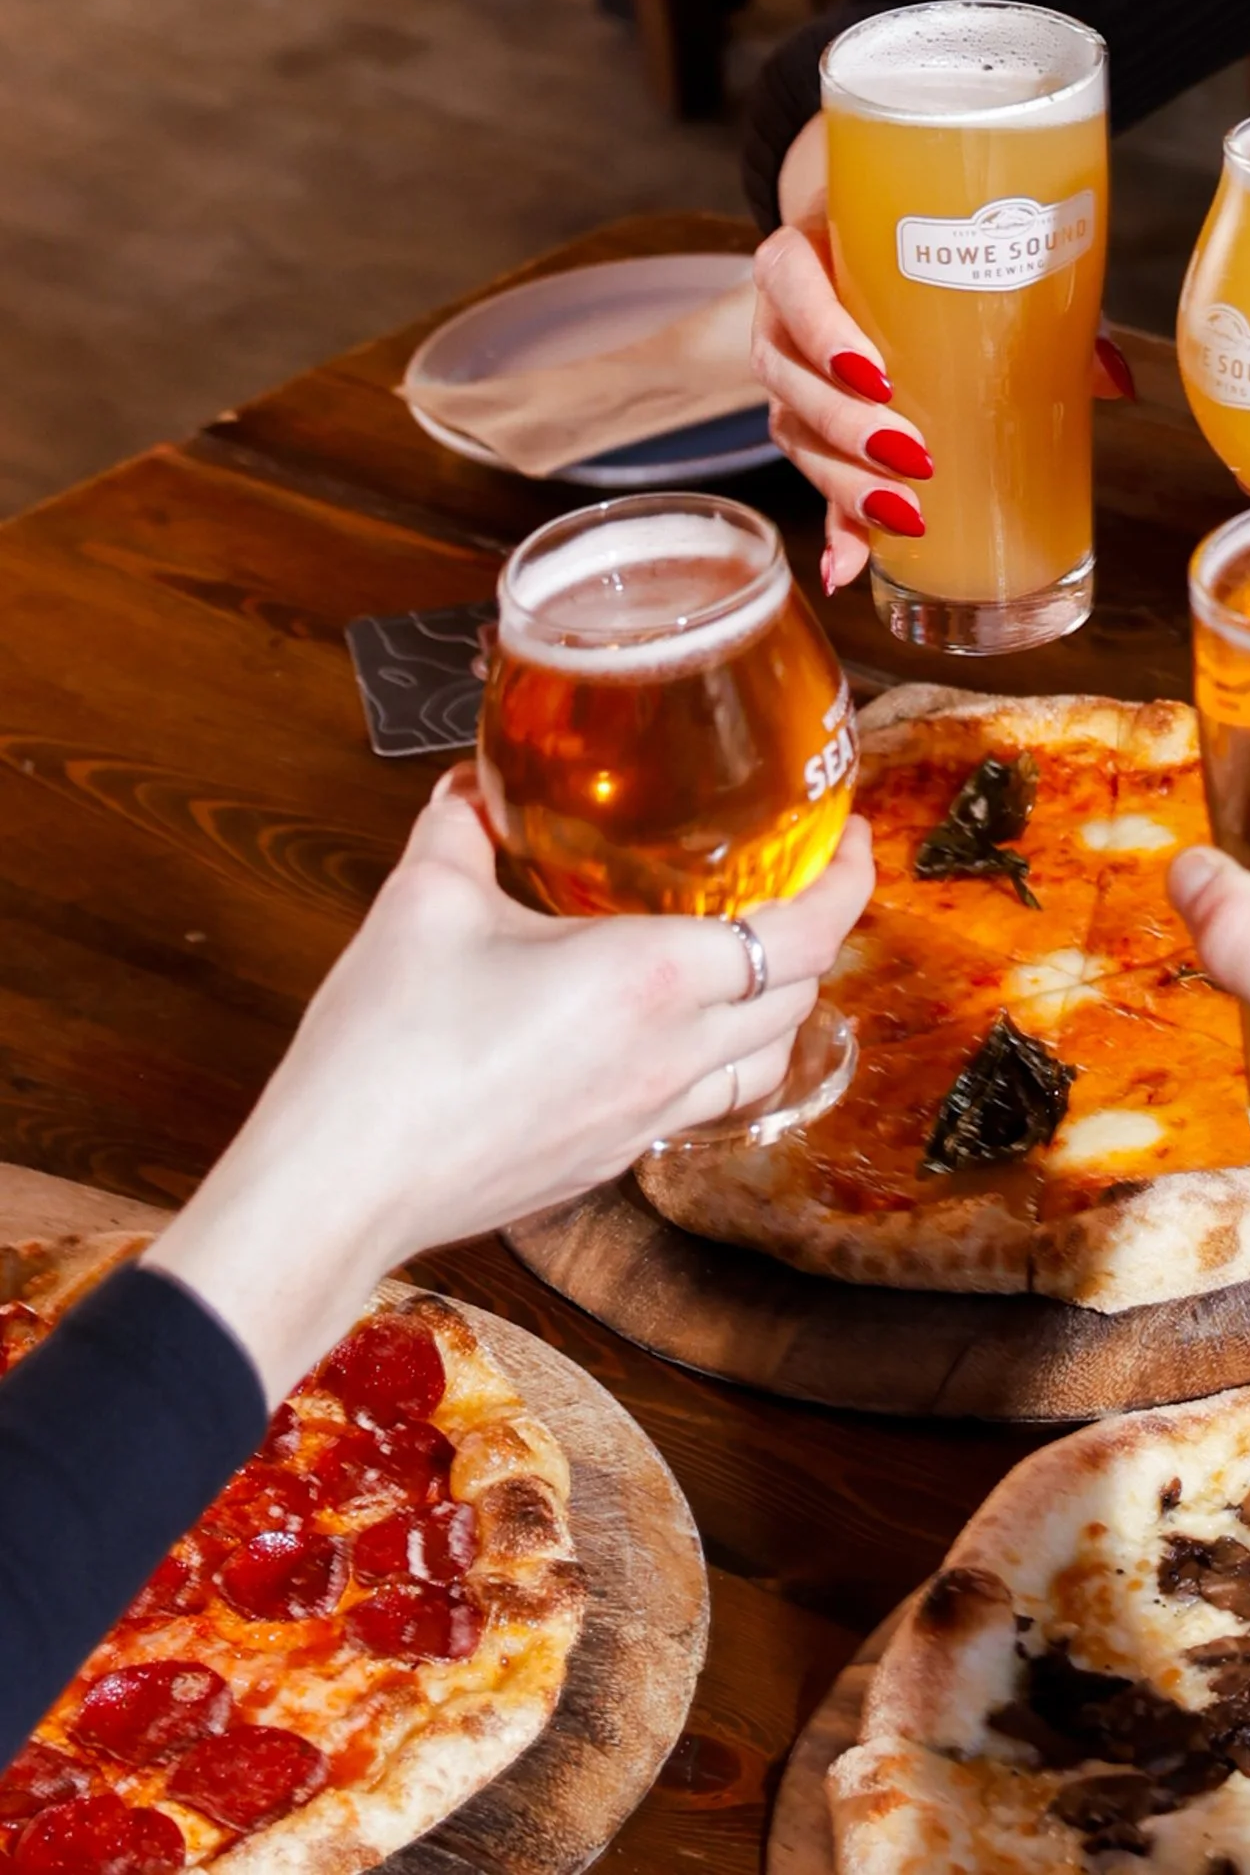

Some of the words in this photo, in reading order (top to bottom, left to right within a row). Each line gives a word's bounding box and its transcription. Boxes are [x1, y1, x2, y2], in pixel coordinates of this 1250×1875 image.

[915, 244, 996, 265] HOWE
[1009, 218, 1087, 261] SOUND
[972, 259, 1045, 280] BREWING
